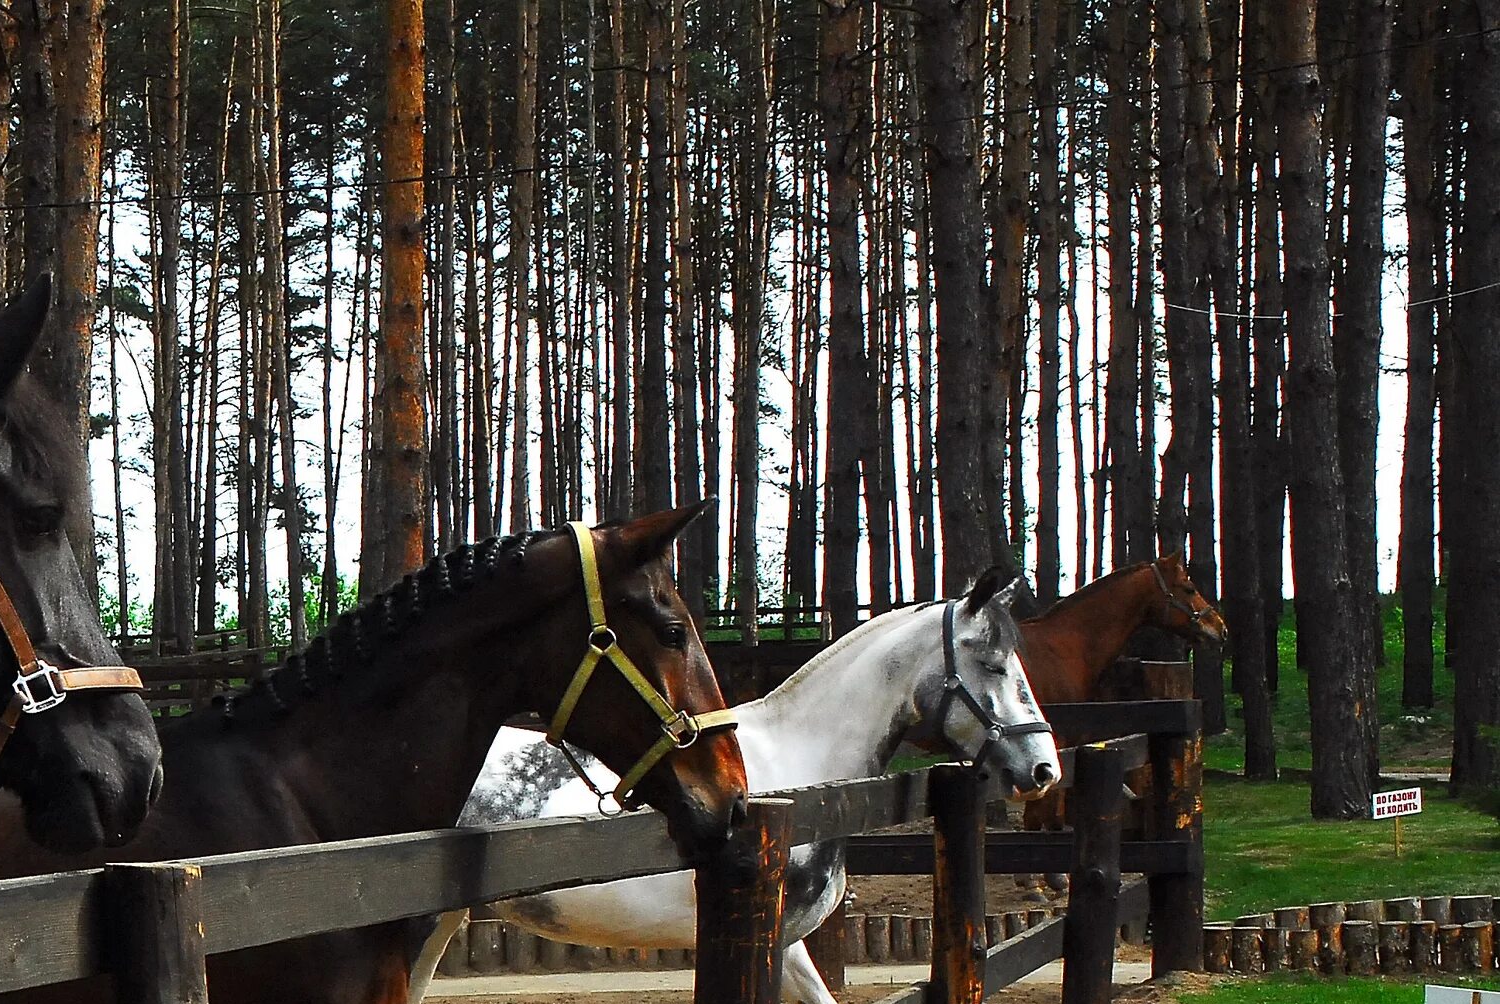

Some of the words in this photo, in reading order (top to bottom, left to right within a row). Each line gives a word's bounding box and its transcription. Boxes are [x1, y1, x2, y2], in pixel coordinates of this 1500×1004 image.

[1376, 795, 1387, 805] ПО
[1388, 791, 1417, 803] ГАЗОНУ
[1376, 806, 1386, 816] НЕ
[1387, 802, 1418, 814] ХОДИТЬ
